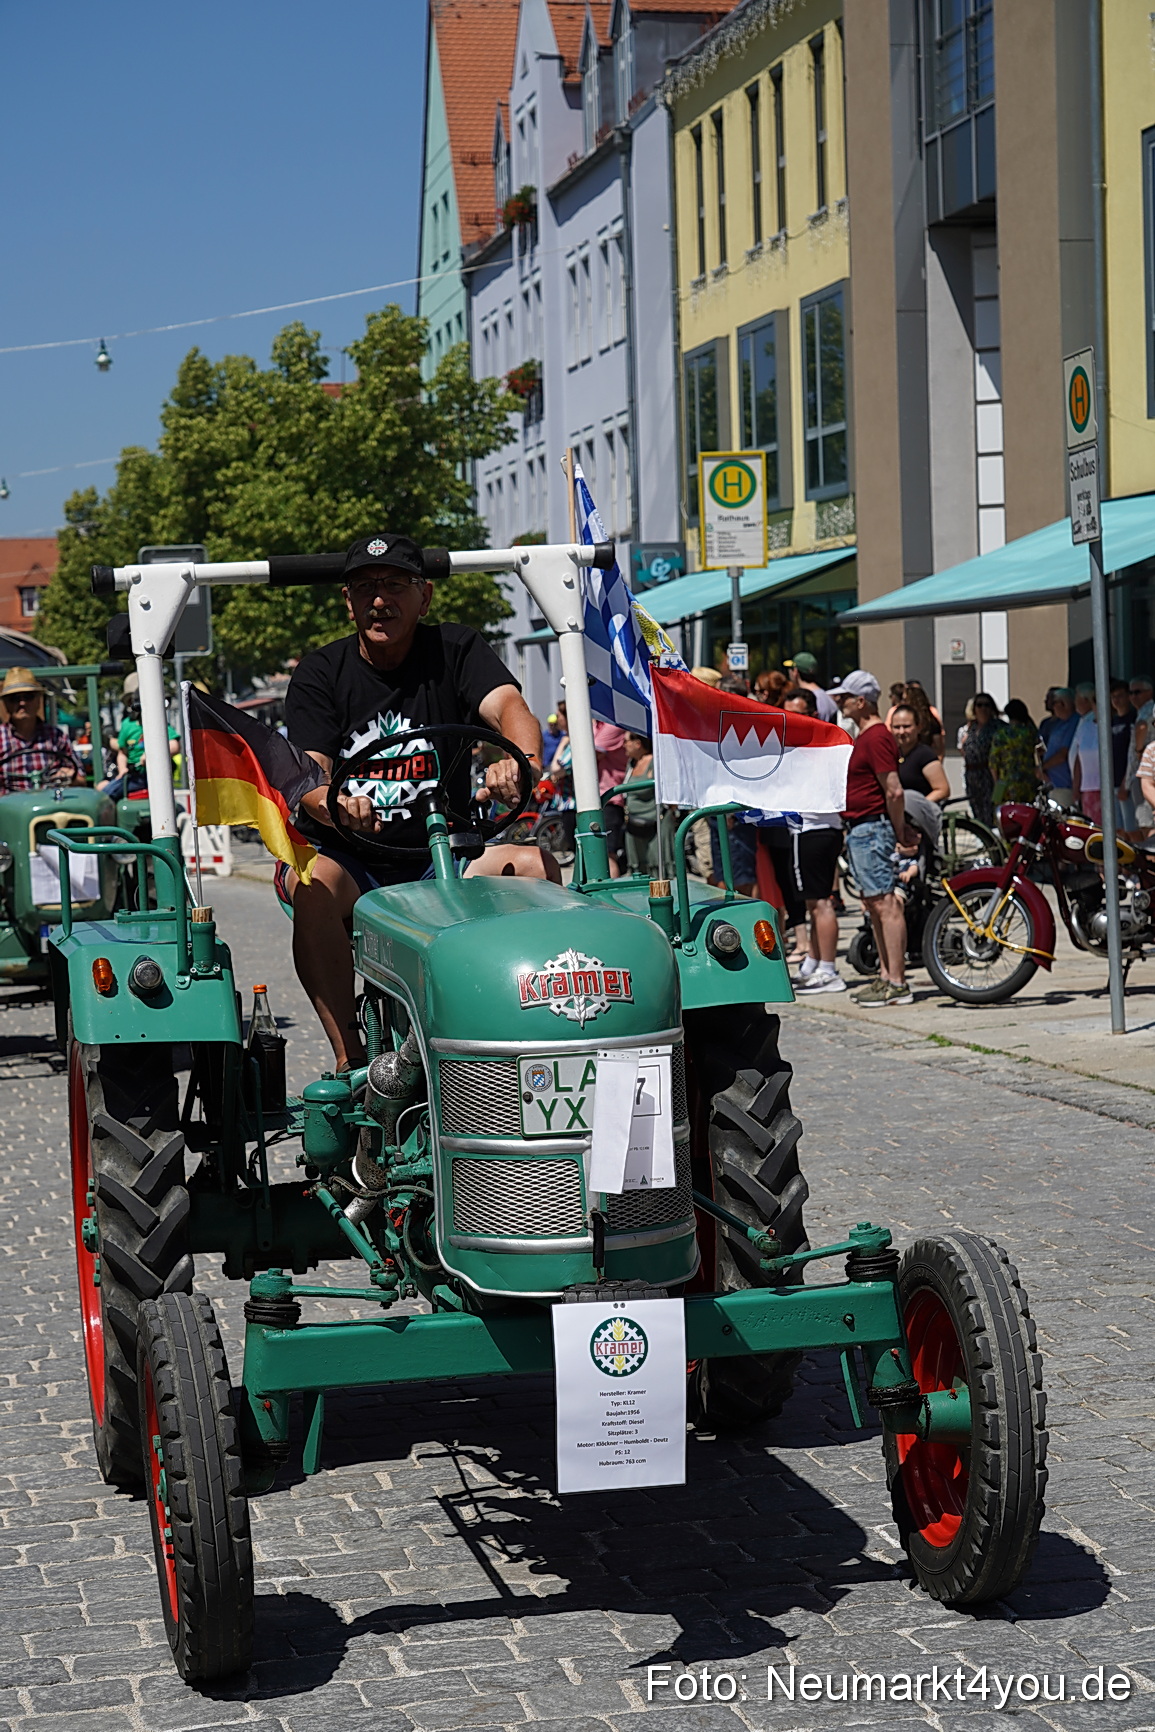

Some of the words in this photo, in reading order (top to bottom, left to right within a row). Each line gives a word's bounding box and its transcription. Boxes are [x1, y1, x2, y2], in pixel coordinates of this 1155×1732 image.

[1070, 457, 1095, 482] Schulbus
[518, 969, 633, 1003] Kramer
[553, 1059, 597, 1093] LA
[536, 1096, 588, 1131] YX
[595, 1340, 644, 1355] Kramer
